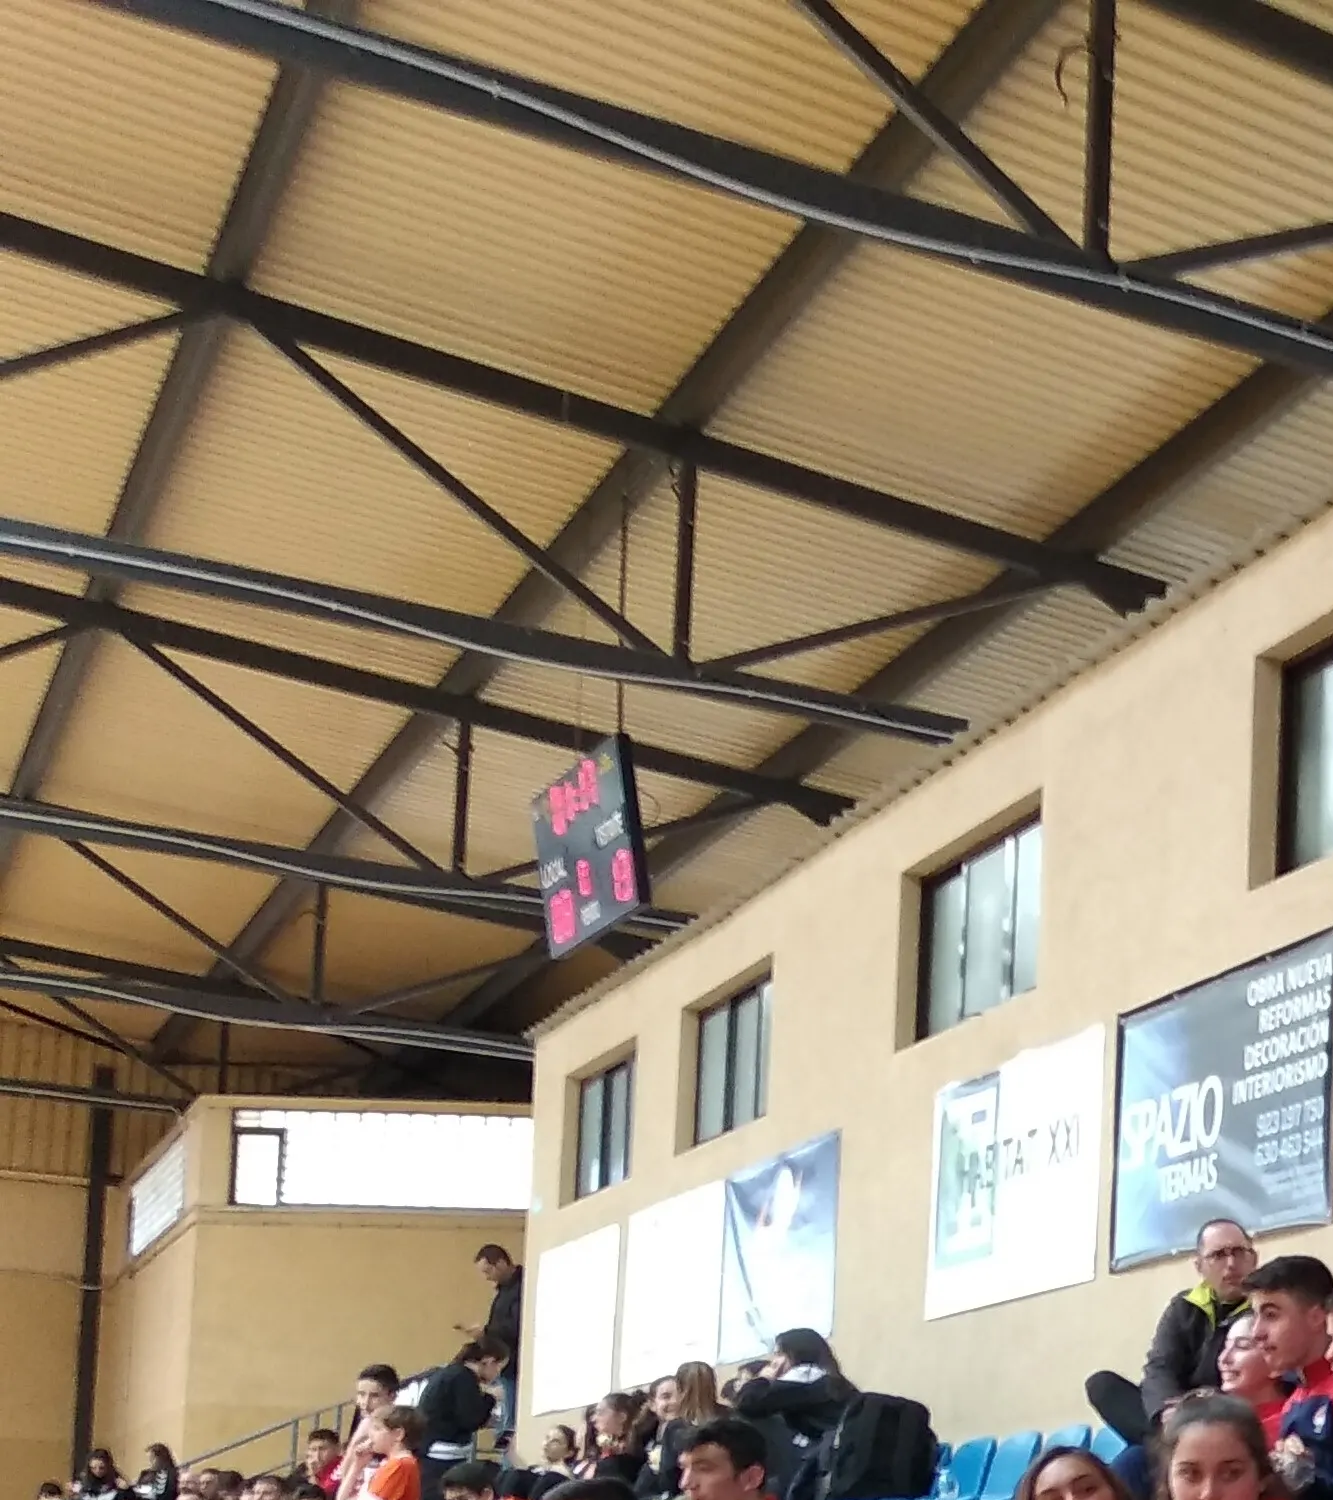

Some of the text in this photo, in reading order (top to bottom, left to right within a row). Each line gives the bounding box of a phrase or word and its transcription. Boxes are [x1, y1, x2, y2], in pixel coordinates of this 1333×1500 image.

[1246, 952, 1333, 1007] OBRA NUEVA
[1258, 984, 1332, 1034] REFORMAS
[1244, 1016, 1330, 1071] DECORACIÓN
[1232, 1051, 1329, 1105] INTERIORISMO
